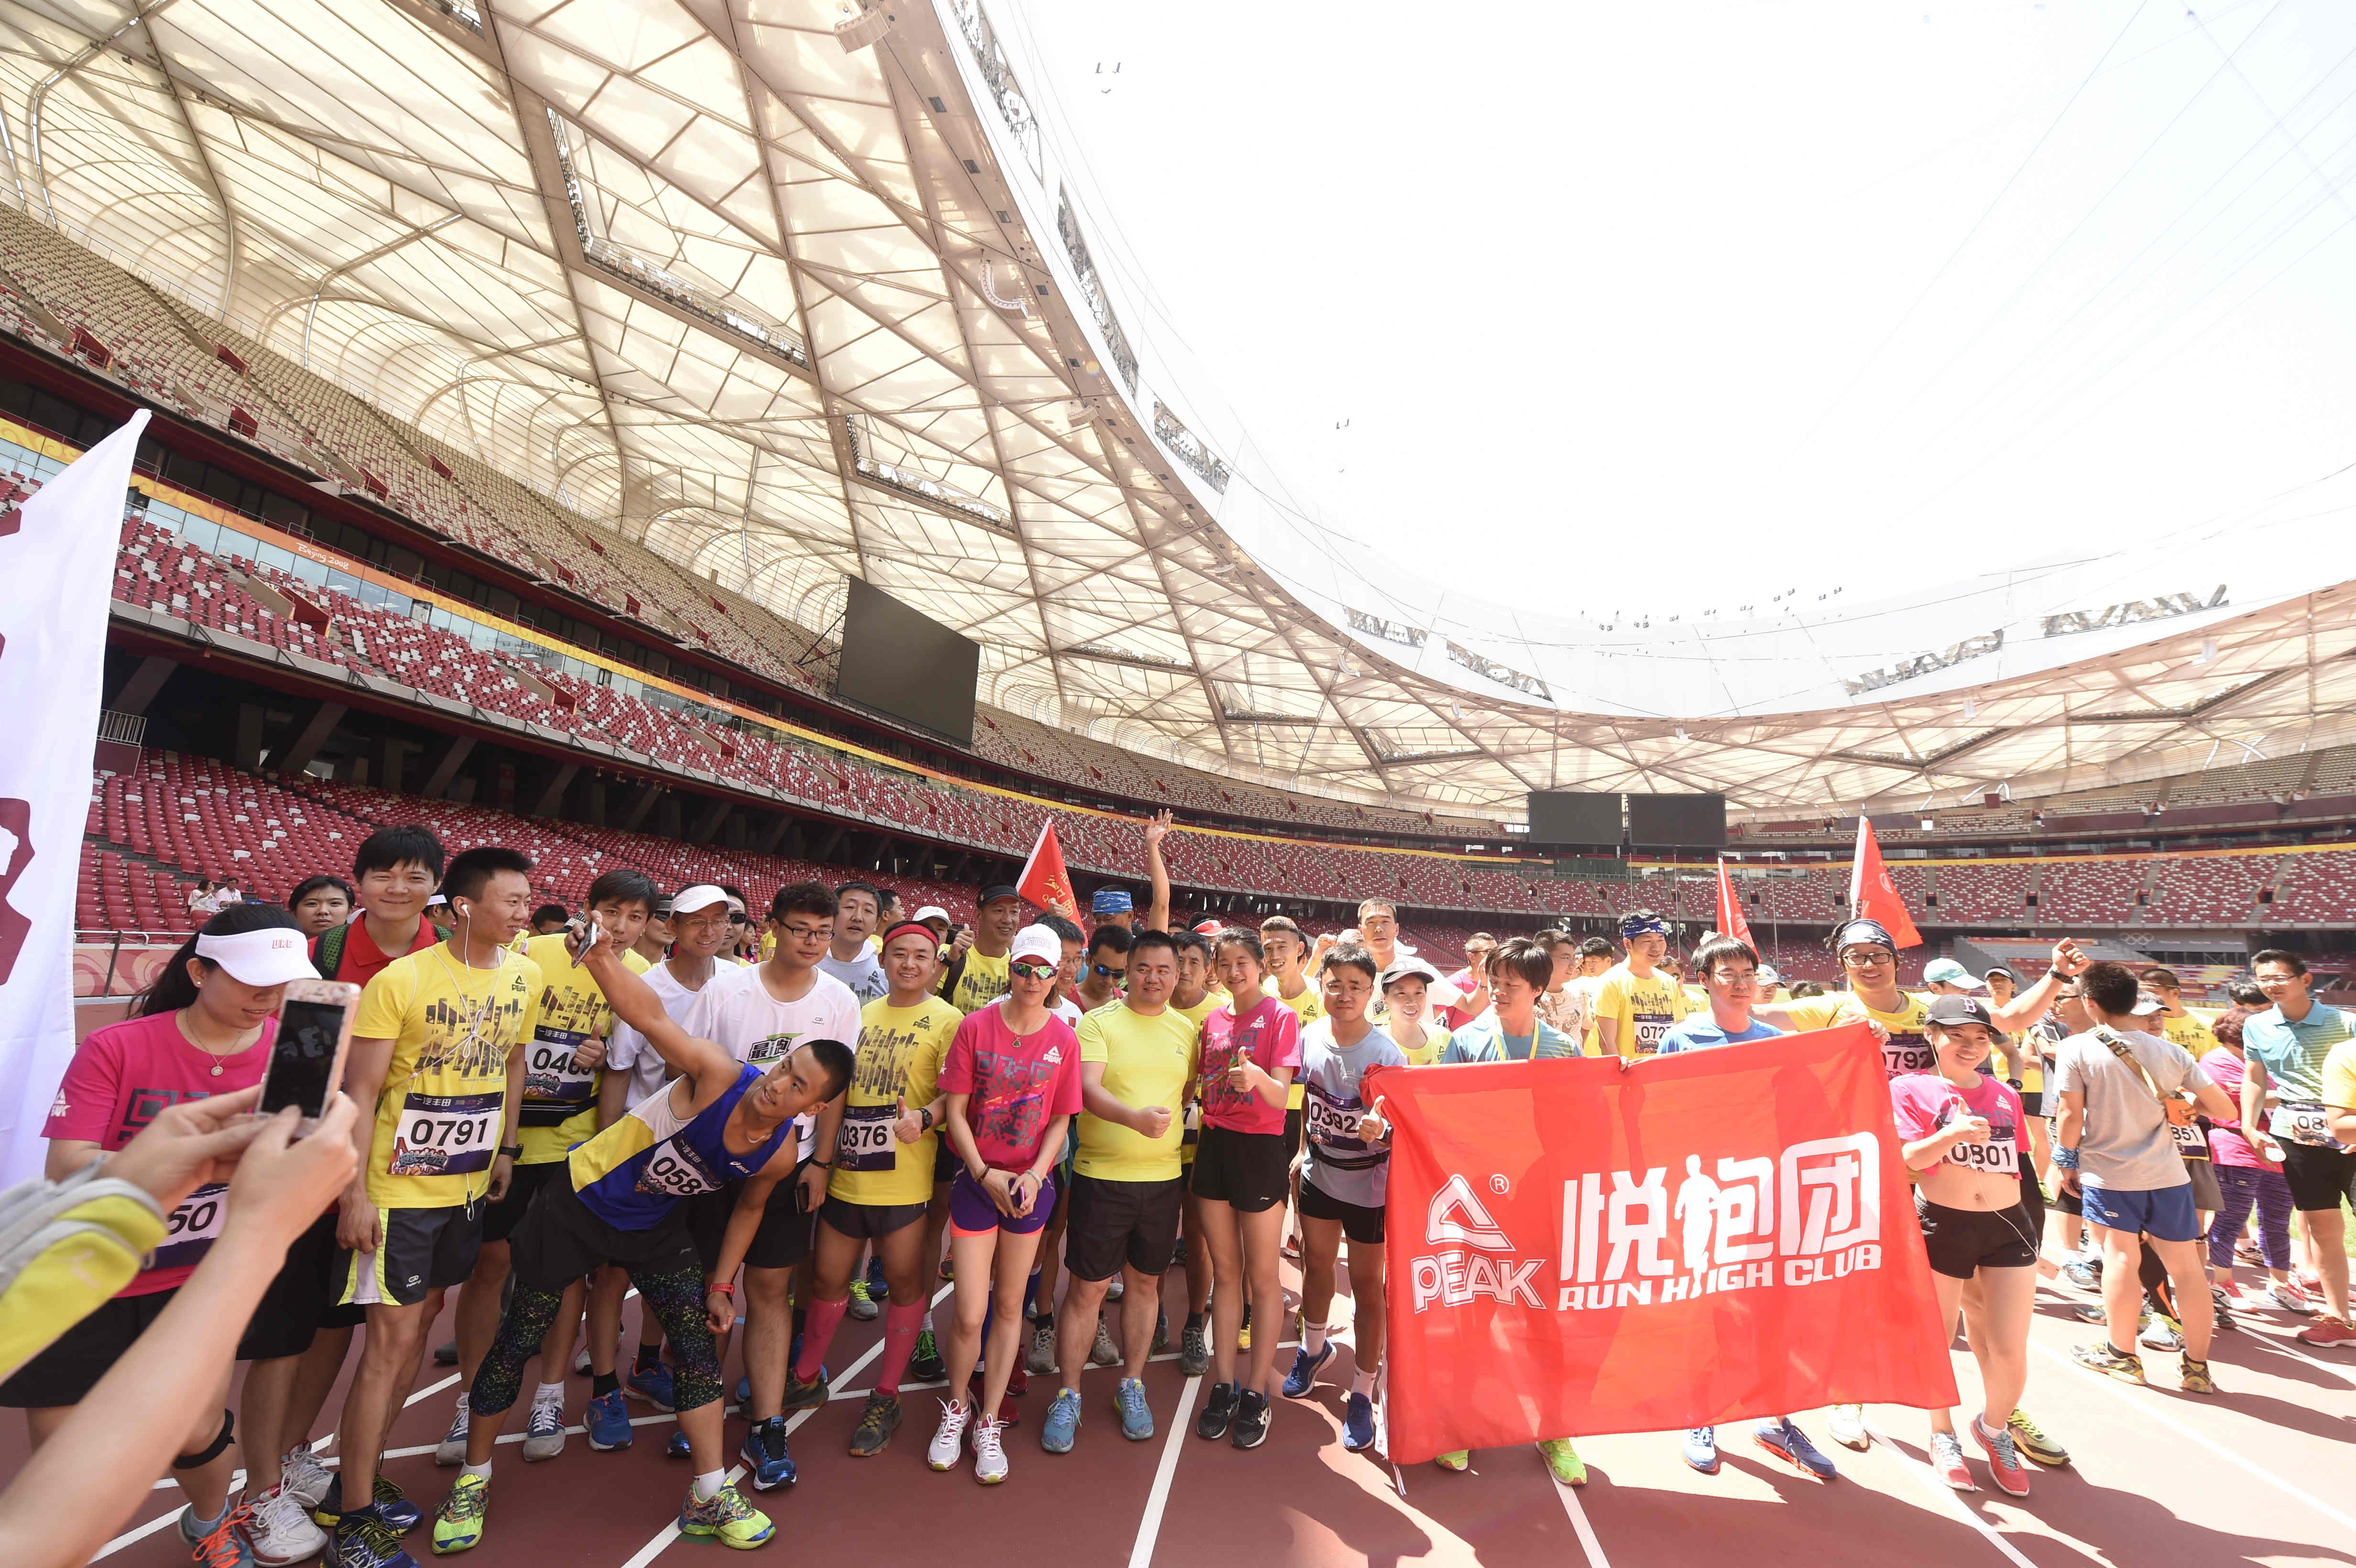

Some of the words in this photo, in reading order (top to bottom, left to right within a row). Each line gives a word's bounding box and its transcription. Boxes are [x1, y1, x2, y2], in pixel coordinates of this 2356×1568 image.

[296, 542, 327, 563] Beijing
[328, 556, 349, 570] 2008
[1960, 997, 1978, 1013] B
[913, 1021, 932, 1031] PEAK
[1043, 1053, 1063, 1065] PEAK
[414, 1097, 452, 1107] 一汽丰田
[1310, 1101, 1358, 1133] 0392
[2297, 1116, 2329, 1131] 08
[410, 1118, 488, 1146] 0791
[841, 1125, 887, 1147] 0376
[652, 1156, 711, 1195] 058
[1410, 1250, 1548, 1315] PEAK
[1557, 1280, 1651, 1311] RUN
[1784, 1243, 1882, 1286] CLUB
